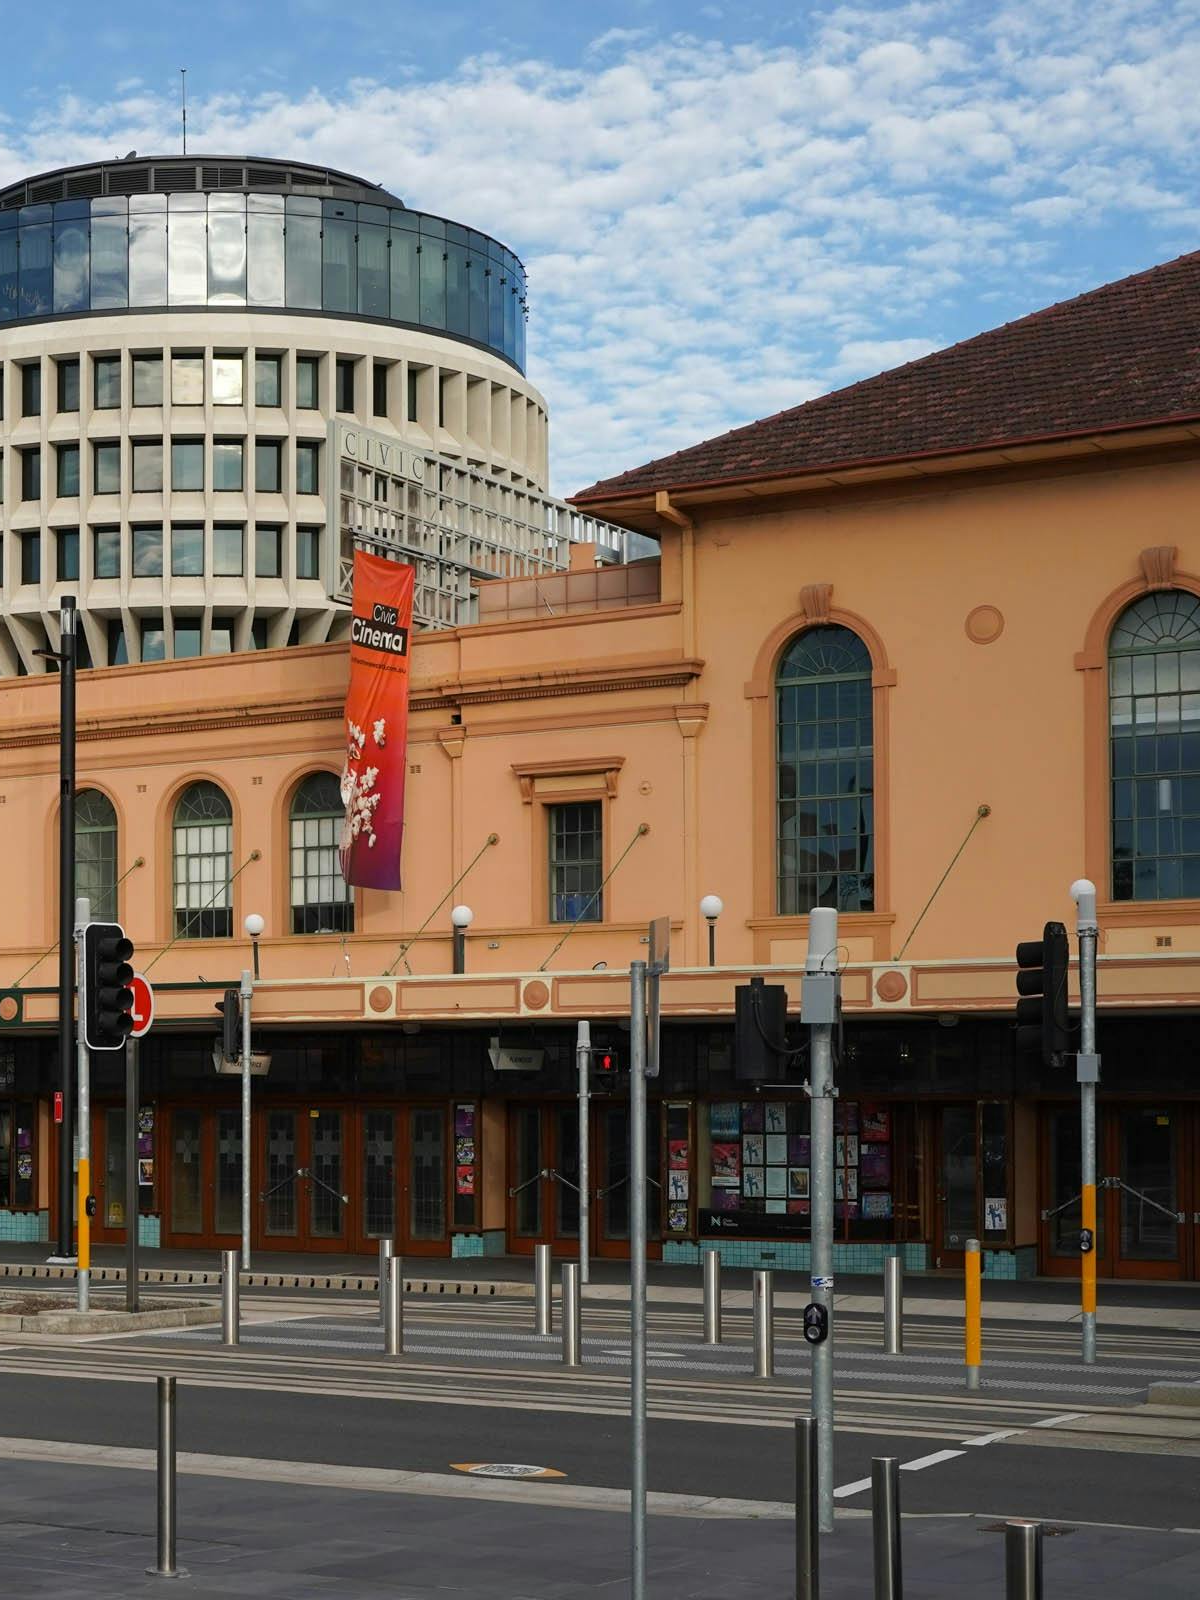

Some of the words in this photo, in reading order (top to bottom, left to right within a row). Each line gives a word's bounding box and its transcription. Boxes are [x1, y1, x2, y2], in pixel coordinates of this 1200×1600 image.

[345, 432, 423, 480] CIVIC
[373, 604, 397, 626] Civic
[352, 618, 403, 652] Cinema
